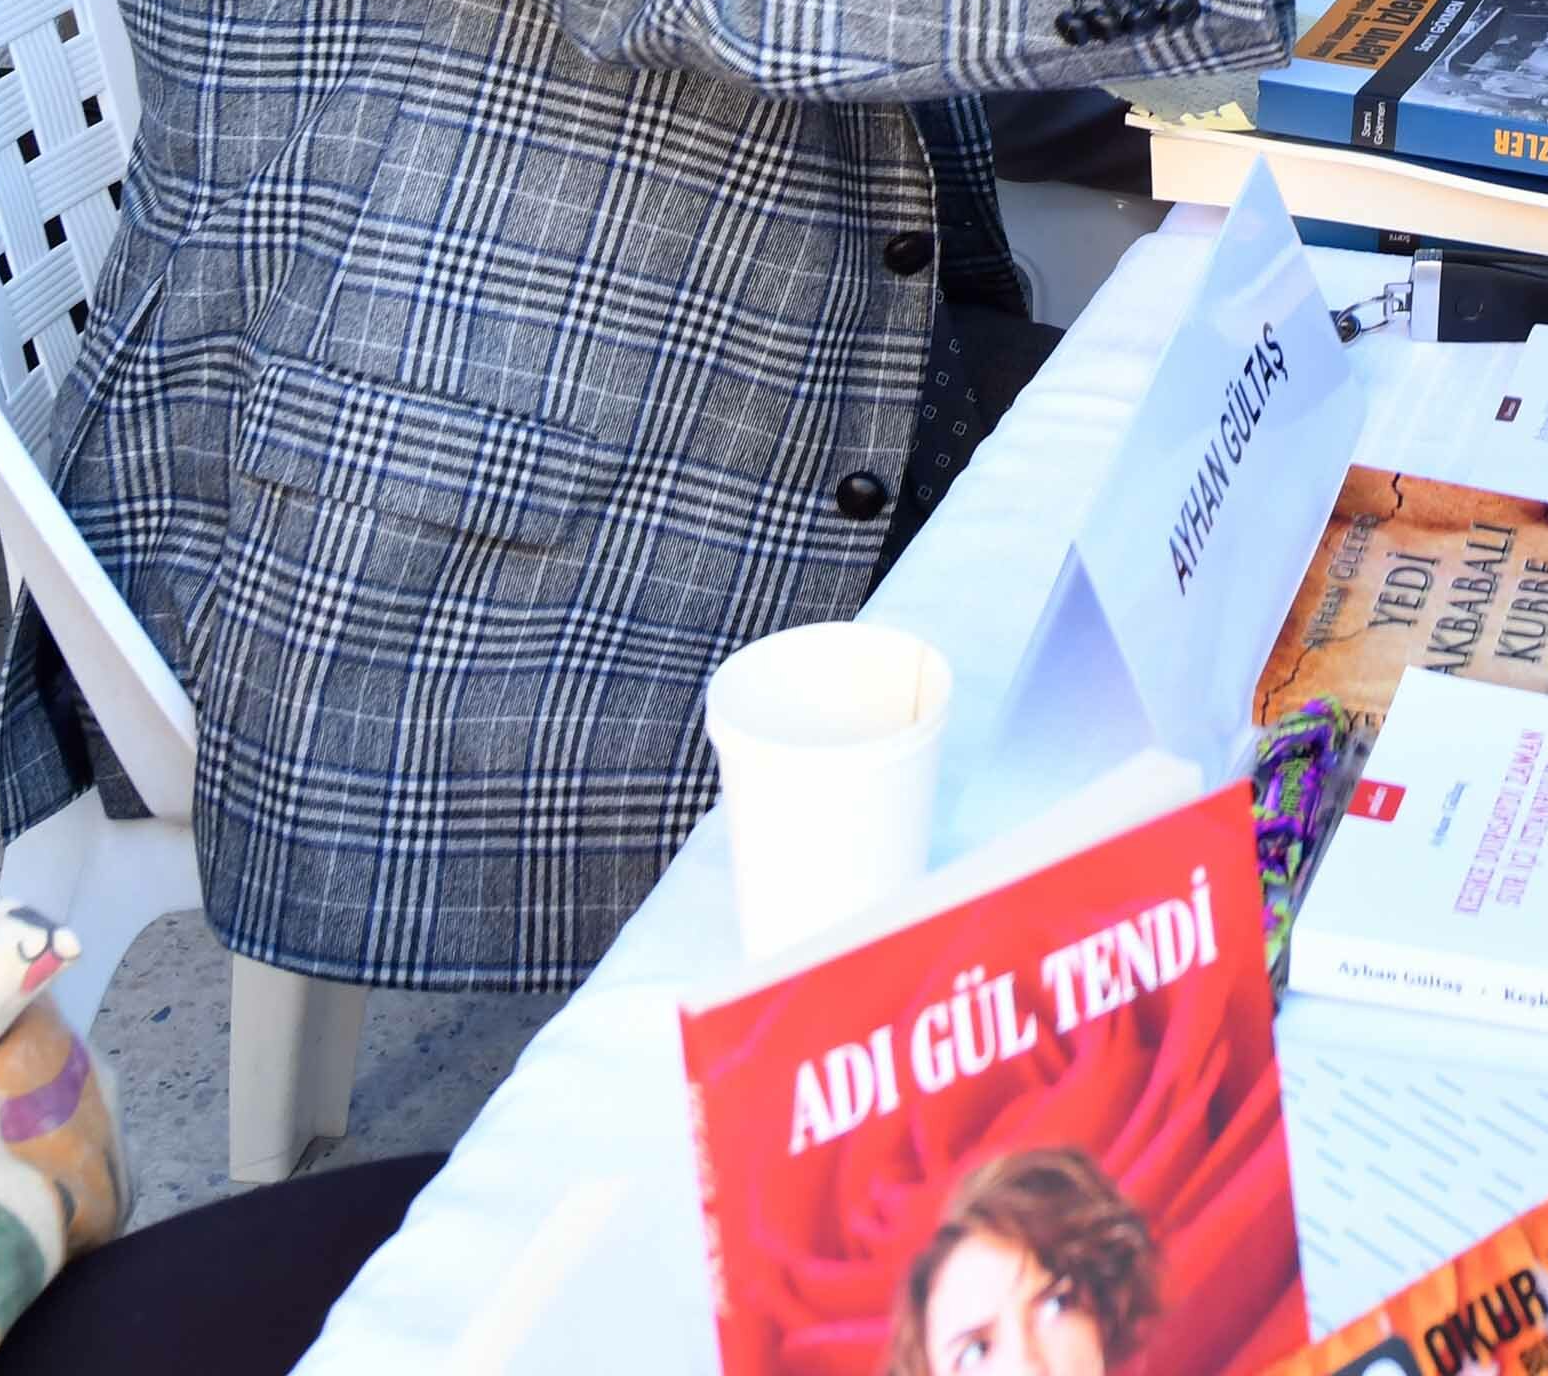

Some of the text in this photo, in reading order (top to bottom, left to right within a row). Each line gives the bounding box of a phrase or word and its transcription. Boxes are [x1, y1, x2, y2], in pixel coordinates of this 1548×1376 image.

[1361, 110, 1372, 138] Sami
[1373, 102, 1386, 146] Gökmen
[1169, 321, 1289, 596] AYHAN GÜLTAŞ
[1367, 550, 1441, 628] YEDİ
[1337, 958, 1397, 987] Ayhan
[1401, 968, 1464, 996] Gültaş
[789, 864, 1218, 1156] ADI GÜL TENDİ
